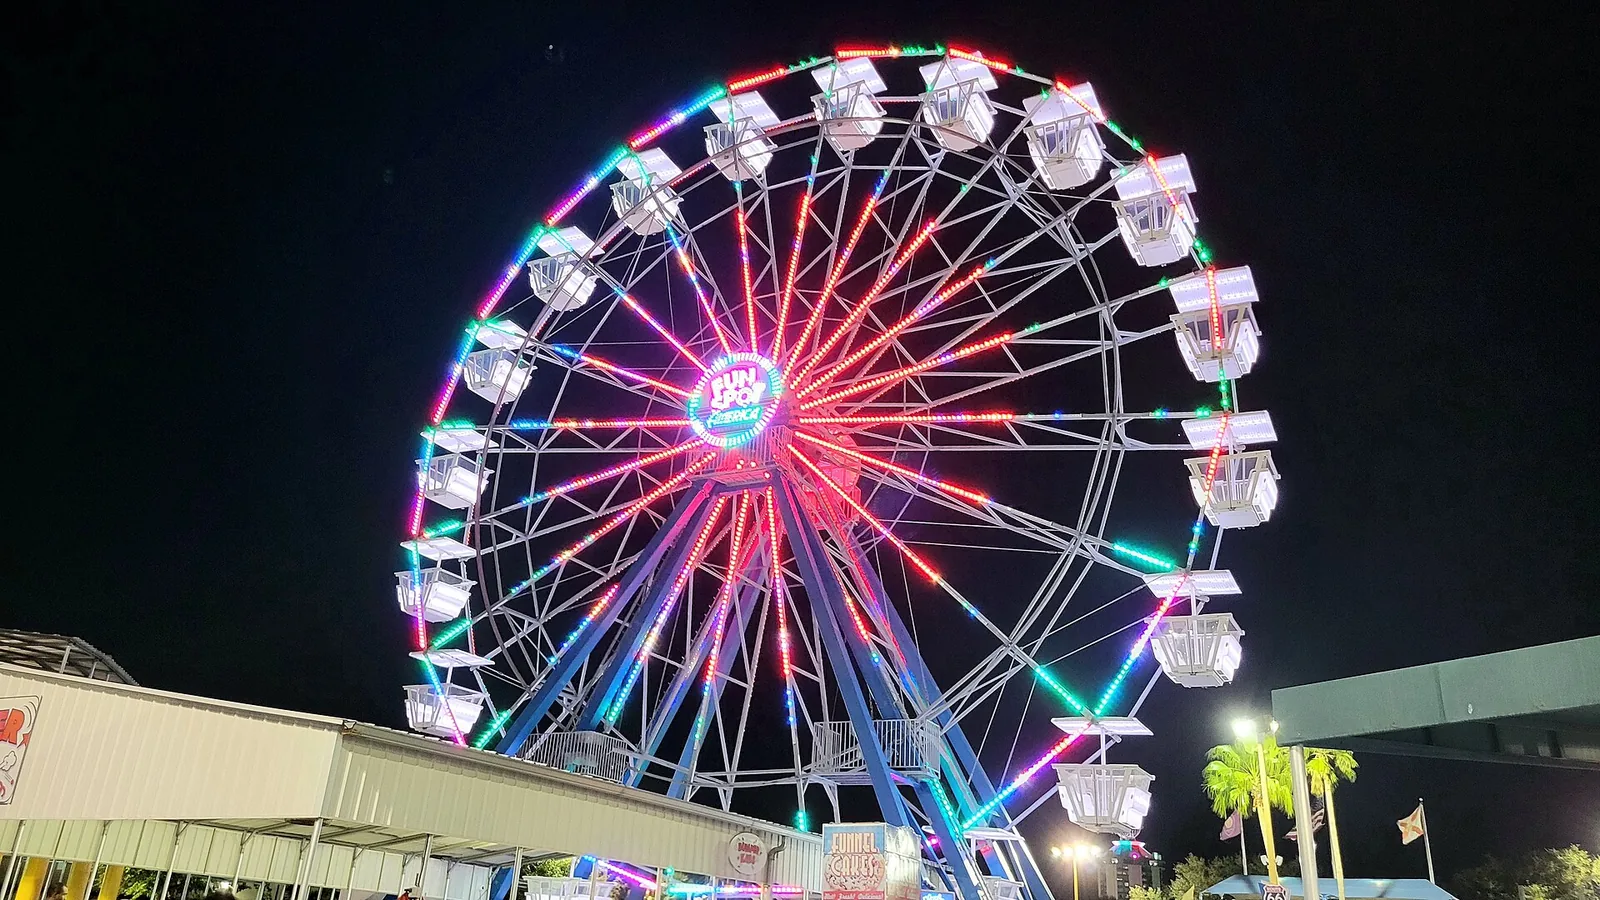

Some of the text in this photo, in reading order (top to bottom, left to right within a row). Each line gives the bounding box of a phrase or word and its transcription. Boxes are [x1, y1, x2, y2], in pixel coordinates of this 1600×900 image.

[711, 367, 756, 399] FUN
[711, 382, 766, 409] SPOT
[832, 832, 880, 854] FUNNEL
[830, 854, 875, 878] CAKES
